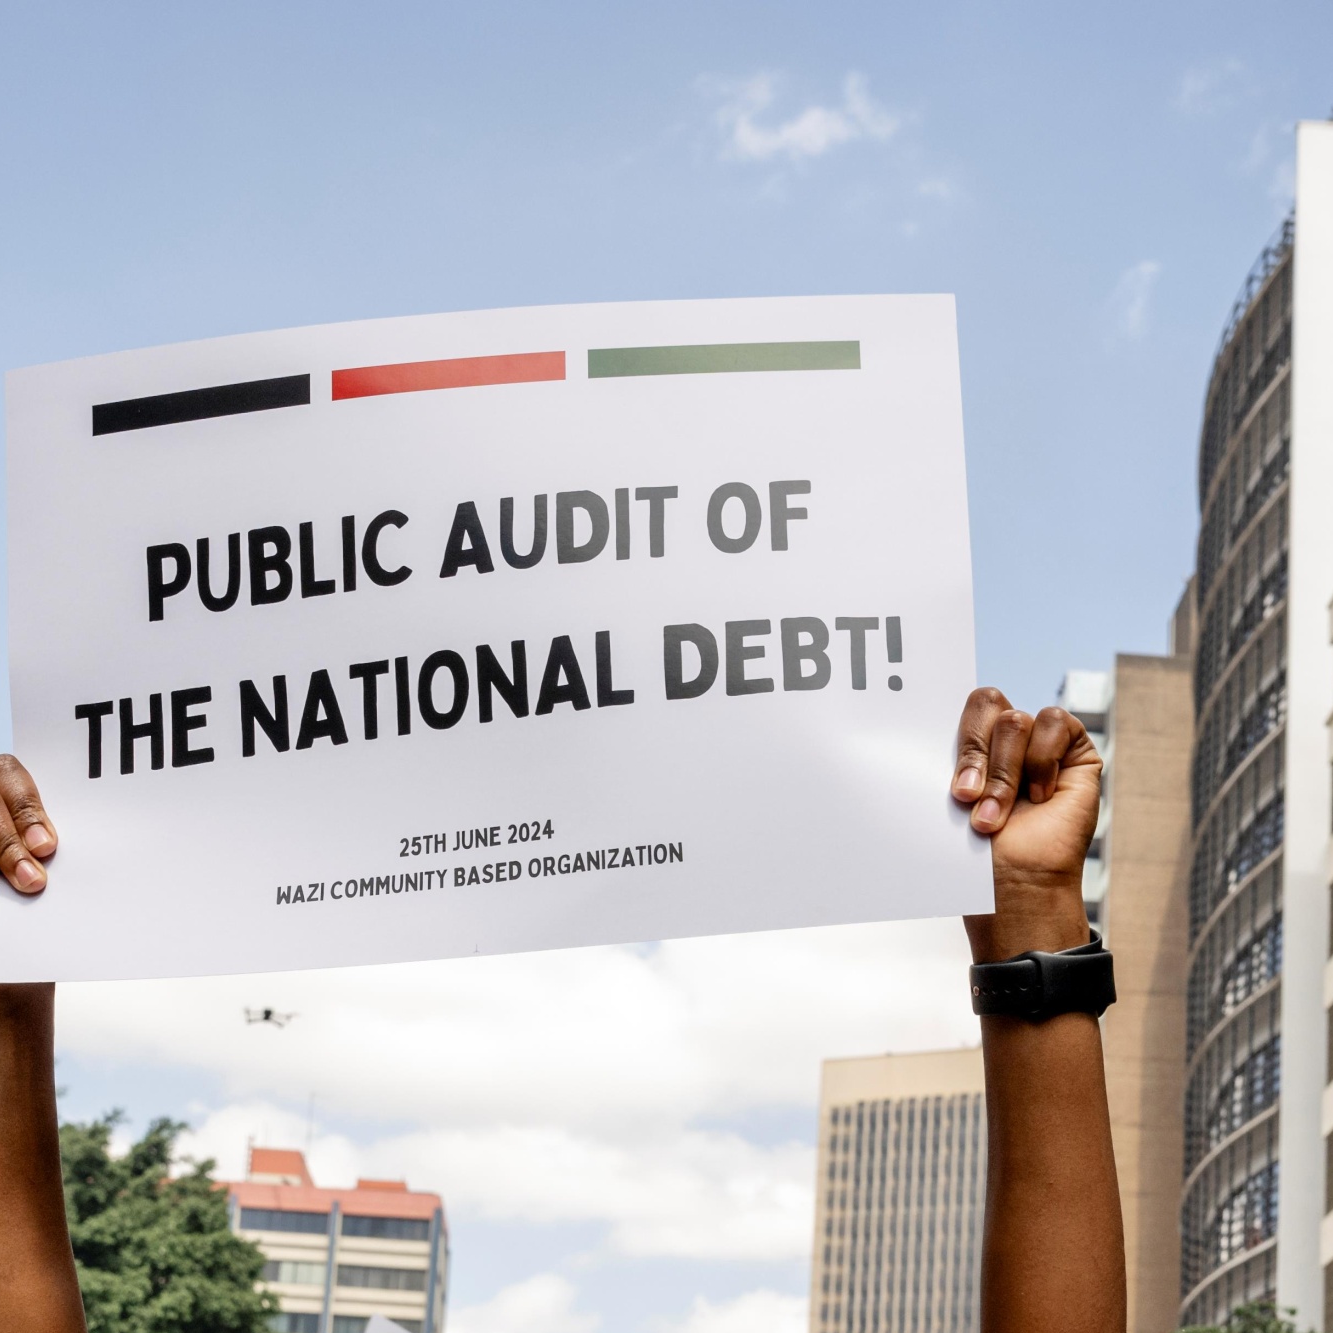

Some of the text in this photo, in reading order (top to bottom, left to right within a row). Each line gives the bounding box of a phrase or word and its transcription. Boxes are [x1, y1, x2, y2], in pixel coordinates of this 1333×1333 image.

[147, 479, 811, 622] PUBLIC AUDIT OF
[75, 615, 903, 779] THE NATIONAL DEBT!
[276, 841, 684, 905] WAZI COMMUNITY BASED ORGANIZATION
[399, 819, 555, 857] 25TH JUNE 2024
